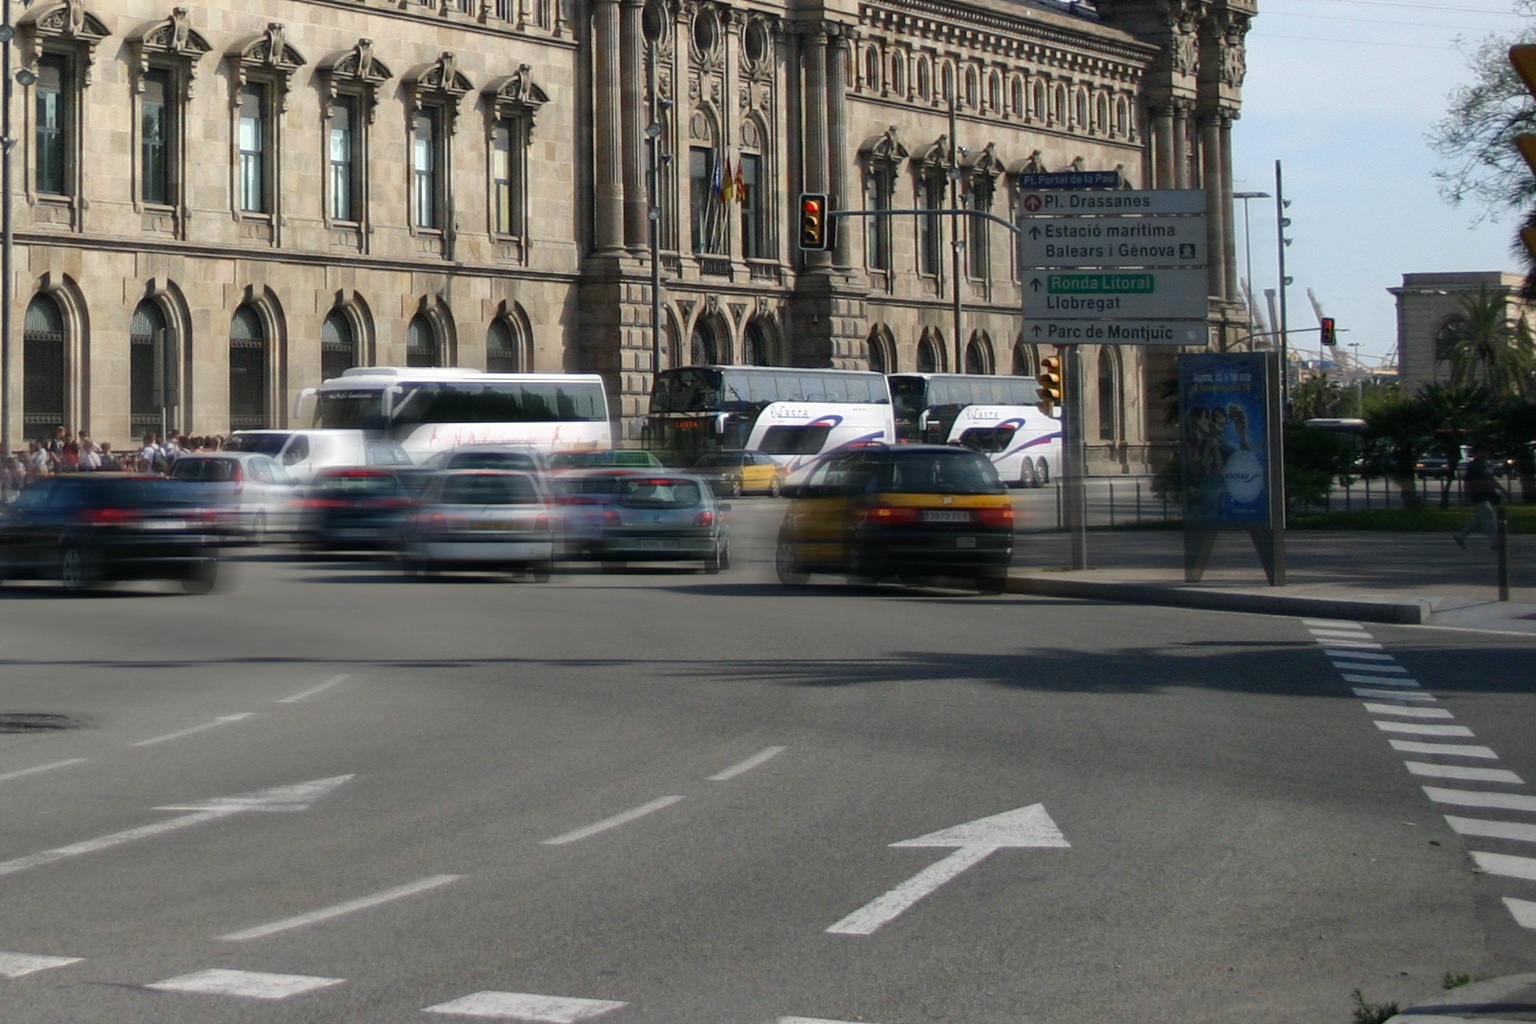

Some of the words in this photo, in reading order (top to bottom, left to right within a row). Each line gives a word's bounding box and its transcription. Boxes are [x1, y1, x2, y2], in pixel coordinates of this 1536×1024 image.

[1038, 175, 1068, 185] Portal
[1070, 175, 1082, 184] de
[1084, 175, 1094, 184] la
[1095, 174, 1114, 184] Pau
[1044, 195, 1064, 208] Pl.
[1070, 195, 1151, 208] Drassanes
[1046, 223, 1102, 238] Estació
[1046, 243, 1104, 258] Balears
[1108, 243, 1113, 257] i
[1118, 243, 1175, 257] Gènova
[1051, 276, 1099, 289] Ronda
[1102, 275, 1150, 289] Litoral
[1047, 296, 1121, 312] Llobregat
[1048, 324, 1081, 338] Parc
[1086, 324, 1103, 338] de
[1107, 325, 1173, 342] Montjuïc
